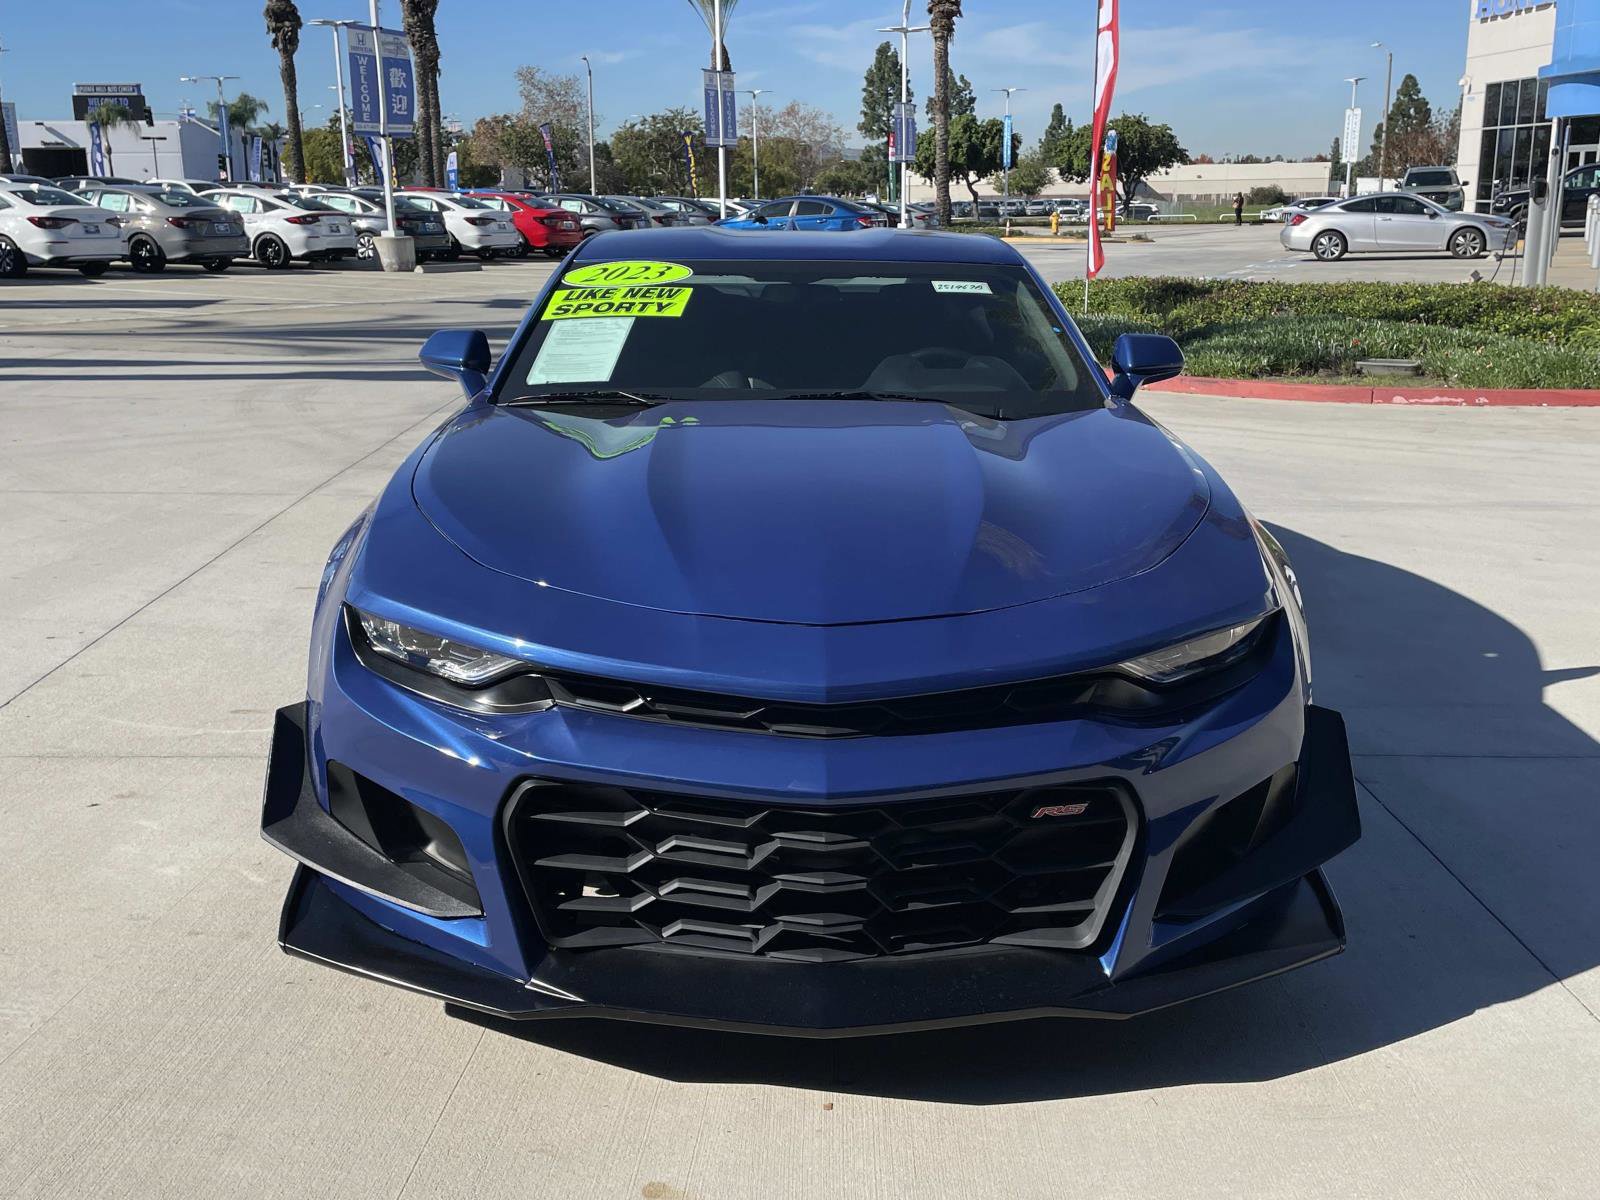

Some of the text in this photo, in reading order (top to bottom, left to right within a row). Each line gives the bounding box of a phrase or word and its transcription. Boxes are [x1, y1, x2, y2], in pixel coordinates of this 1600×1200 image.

[356, 55, 371, 122] WELCOME
[580, 265, 673, 282] 2023
[562, 287, 684, 301] LIKE NEW
[551, 301, 676, 316] SPORTY
[1030, 803, 1089, 819] RS
